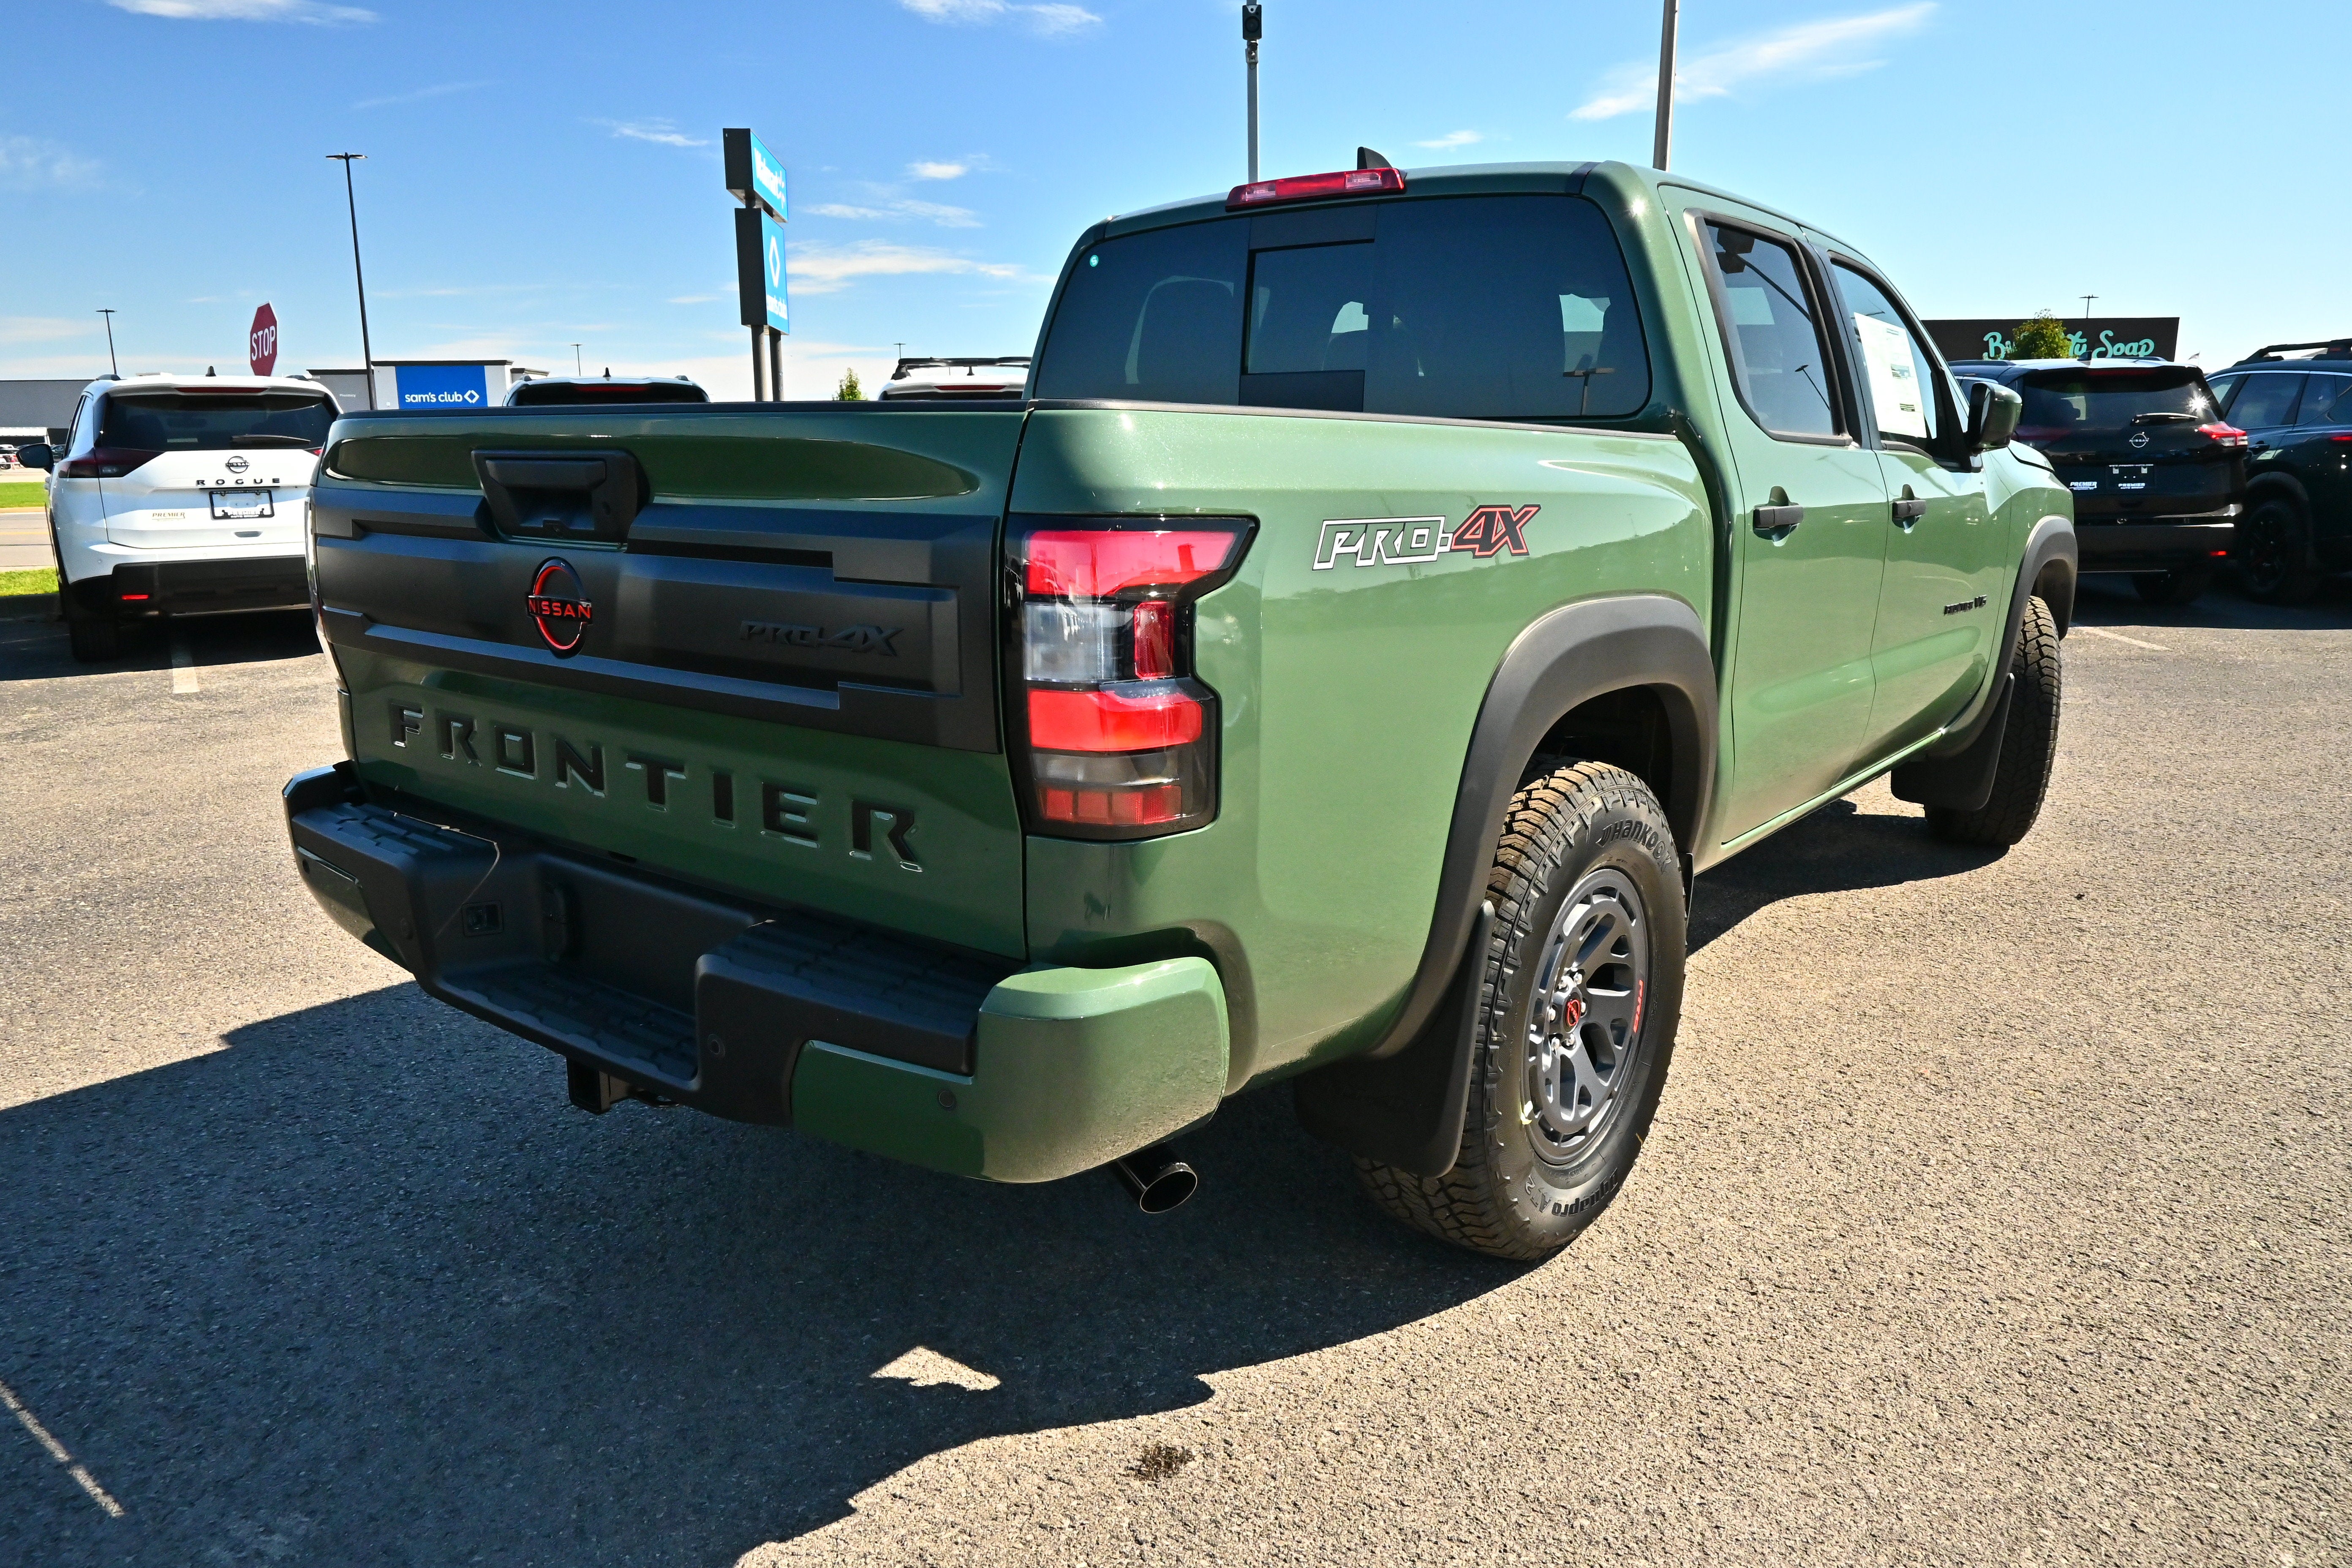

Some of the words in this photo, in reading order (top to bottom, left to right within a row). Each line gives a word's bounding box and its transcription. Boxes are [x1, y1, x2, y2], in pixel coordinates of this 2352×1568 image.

[251, 325, 276, 361] STOP
[2091, 330, 2155, 359] Soap
[405, 392, 436, 403] sam's
[438, 391, 463, 402] club
[528, 598, 591, 619] NISSAN
[389, 699, 923, 873] FRONTIER
